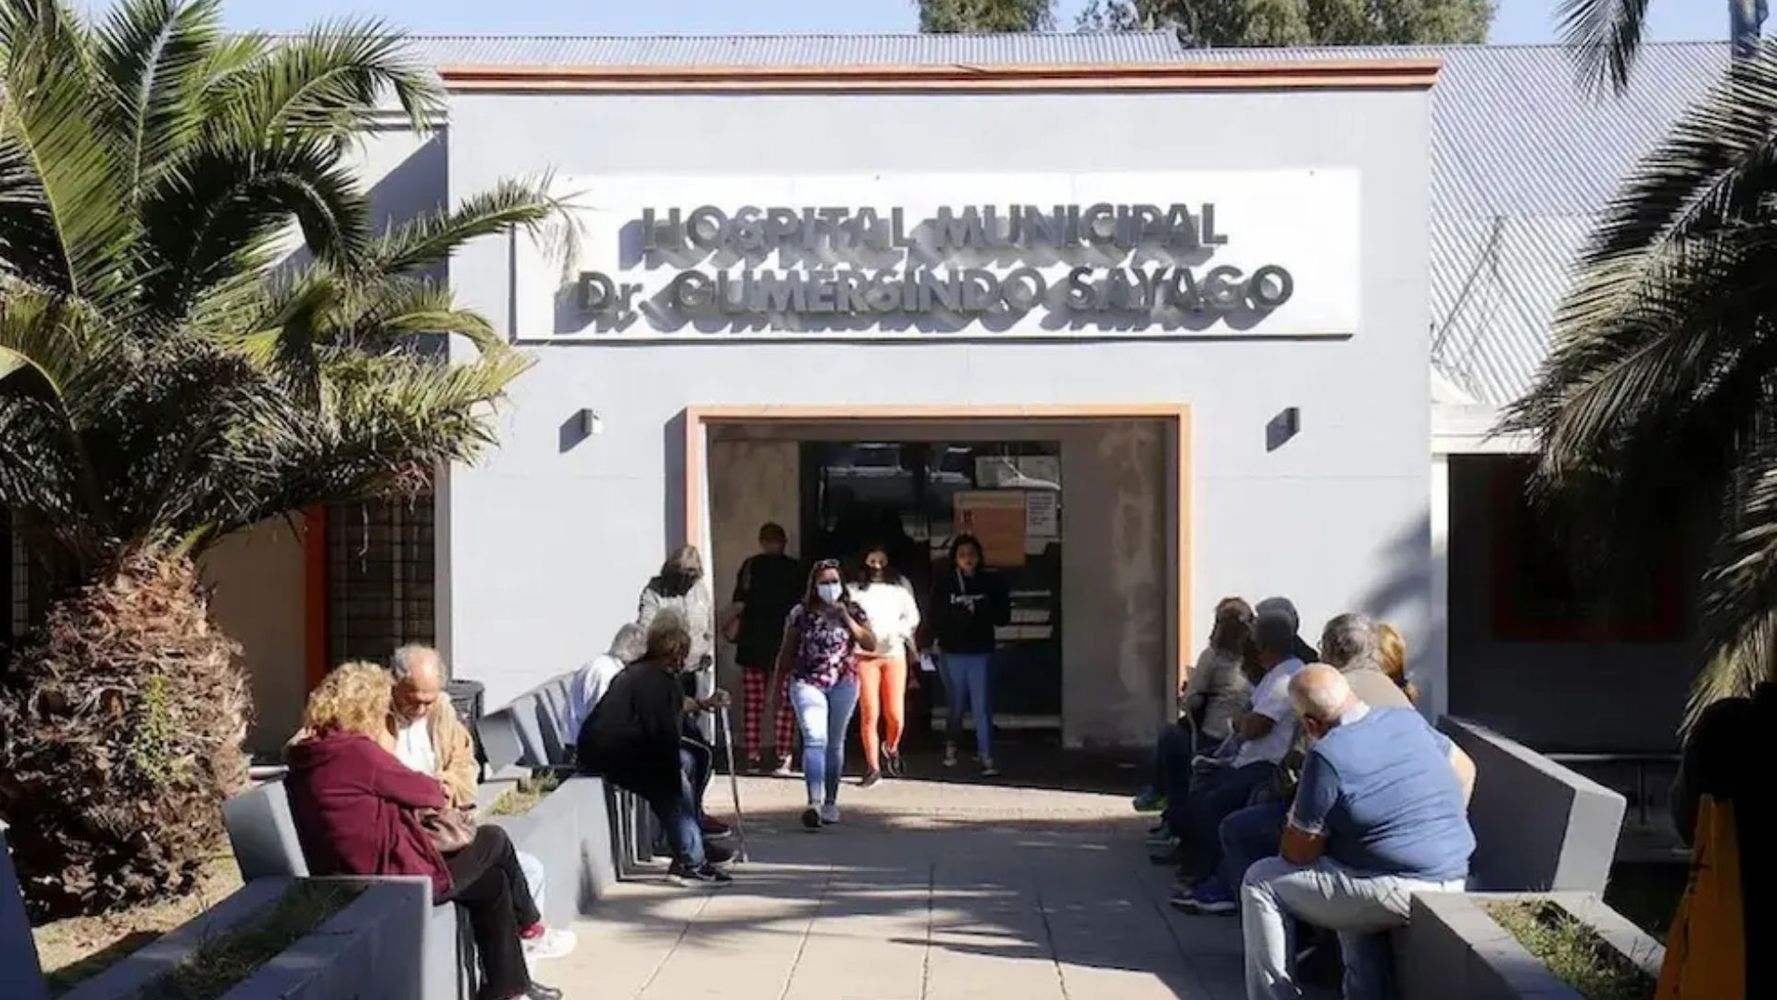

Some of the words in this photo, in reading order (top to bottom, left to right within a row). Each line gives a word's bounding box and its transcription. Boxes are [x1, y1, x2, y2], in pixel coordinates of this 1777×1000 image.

[641, 204, 908, 249] HOSPITAL
[936, 203, 1228, 247] MUNICIPAL
[578, 271, 651, 313] Dr.
[674, 267, 1046, 313] GUMERSINDO
[1069, 265, 1294, 312] SAYAGO
